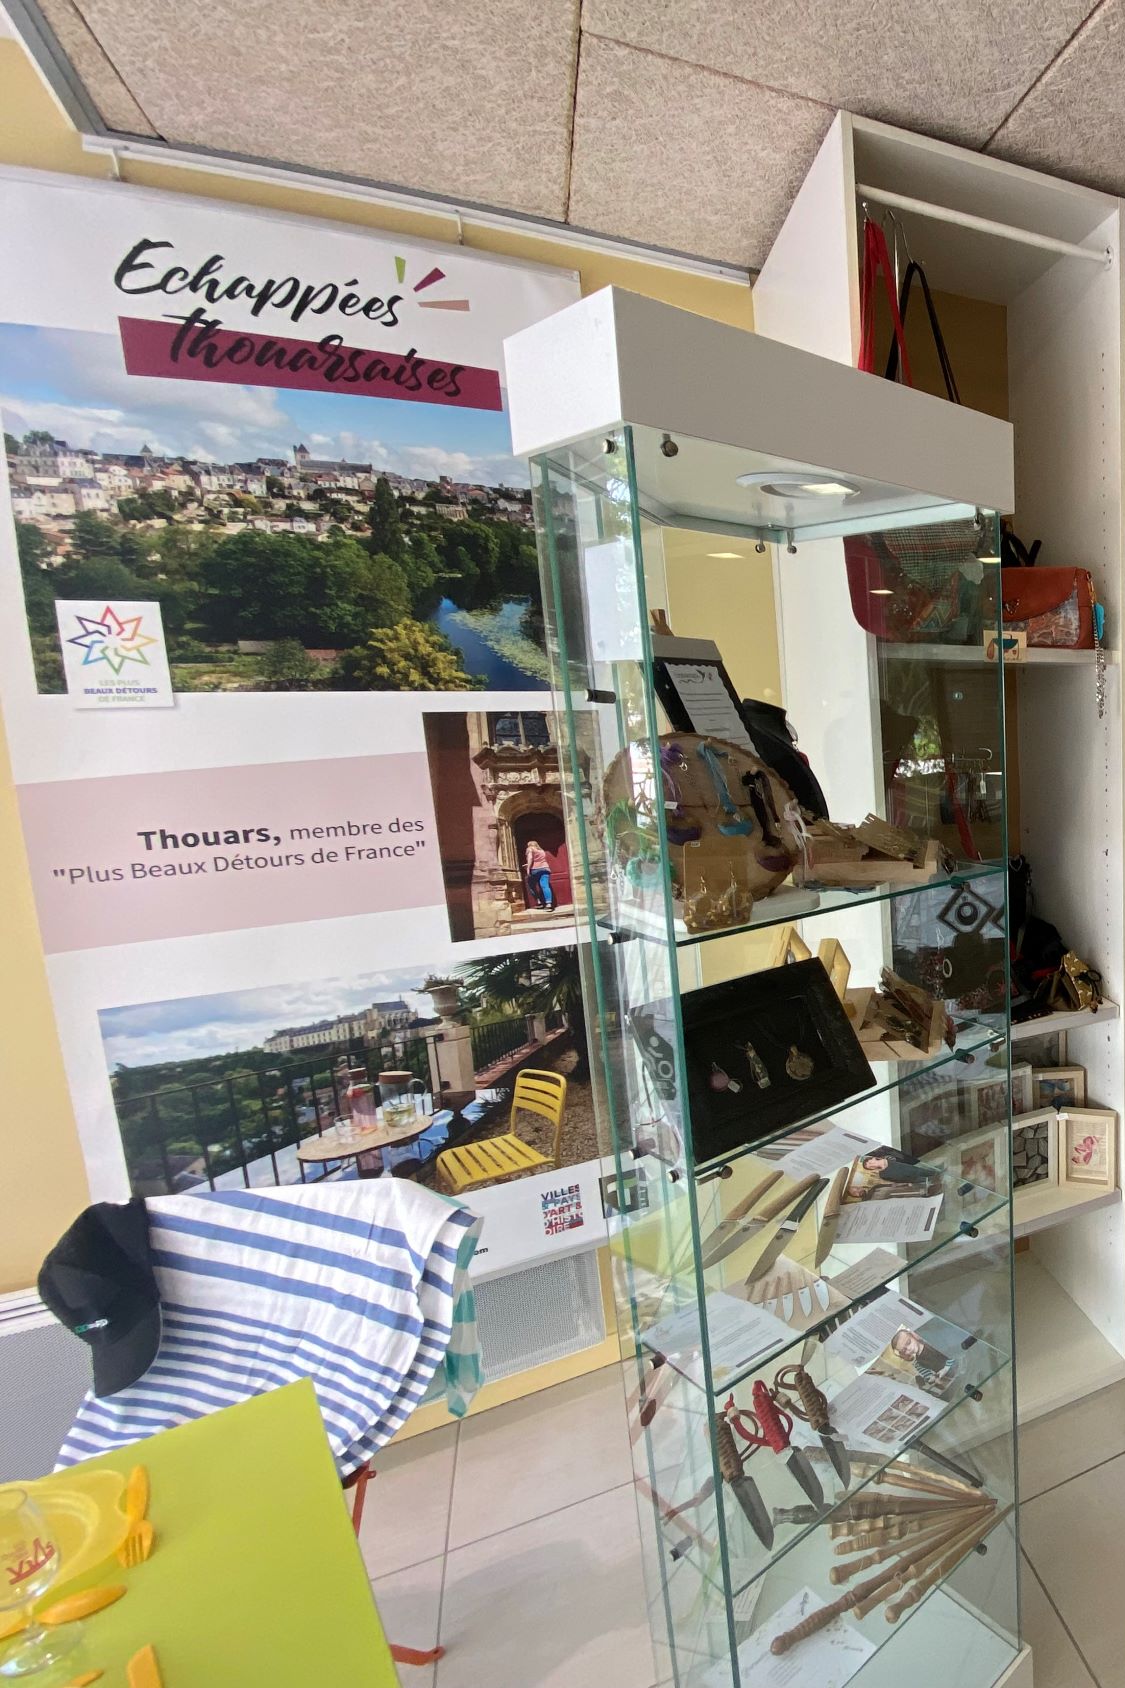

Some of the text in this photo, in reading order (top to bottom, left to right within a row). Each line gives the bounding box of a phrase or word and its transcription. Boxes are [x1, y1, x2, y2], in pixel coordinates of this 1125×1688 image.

[114, 238, 404, 328] Echappées
[162, 308, 466, 398] thouarsaises
[137, 817, 424, 851] Thouars, membre des
[53, 840, 426, 885] "Plus Beaux Détours de France"
[541, 1183, 580, 1200] VILLES
